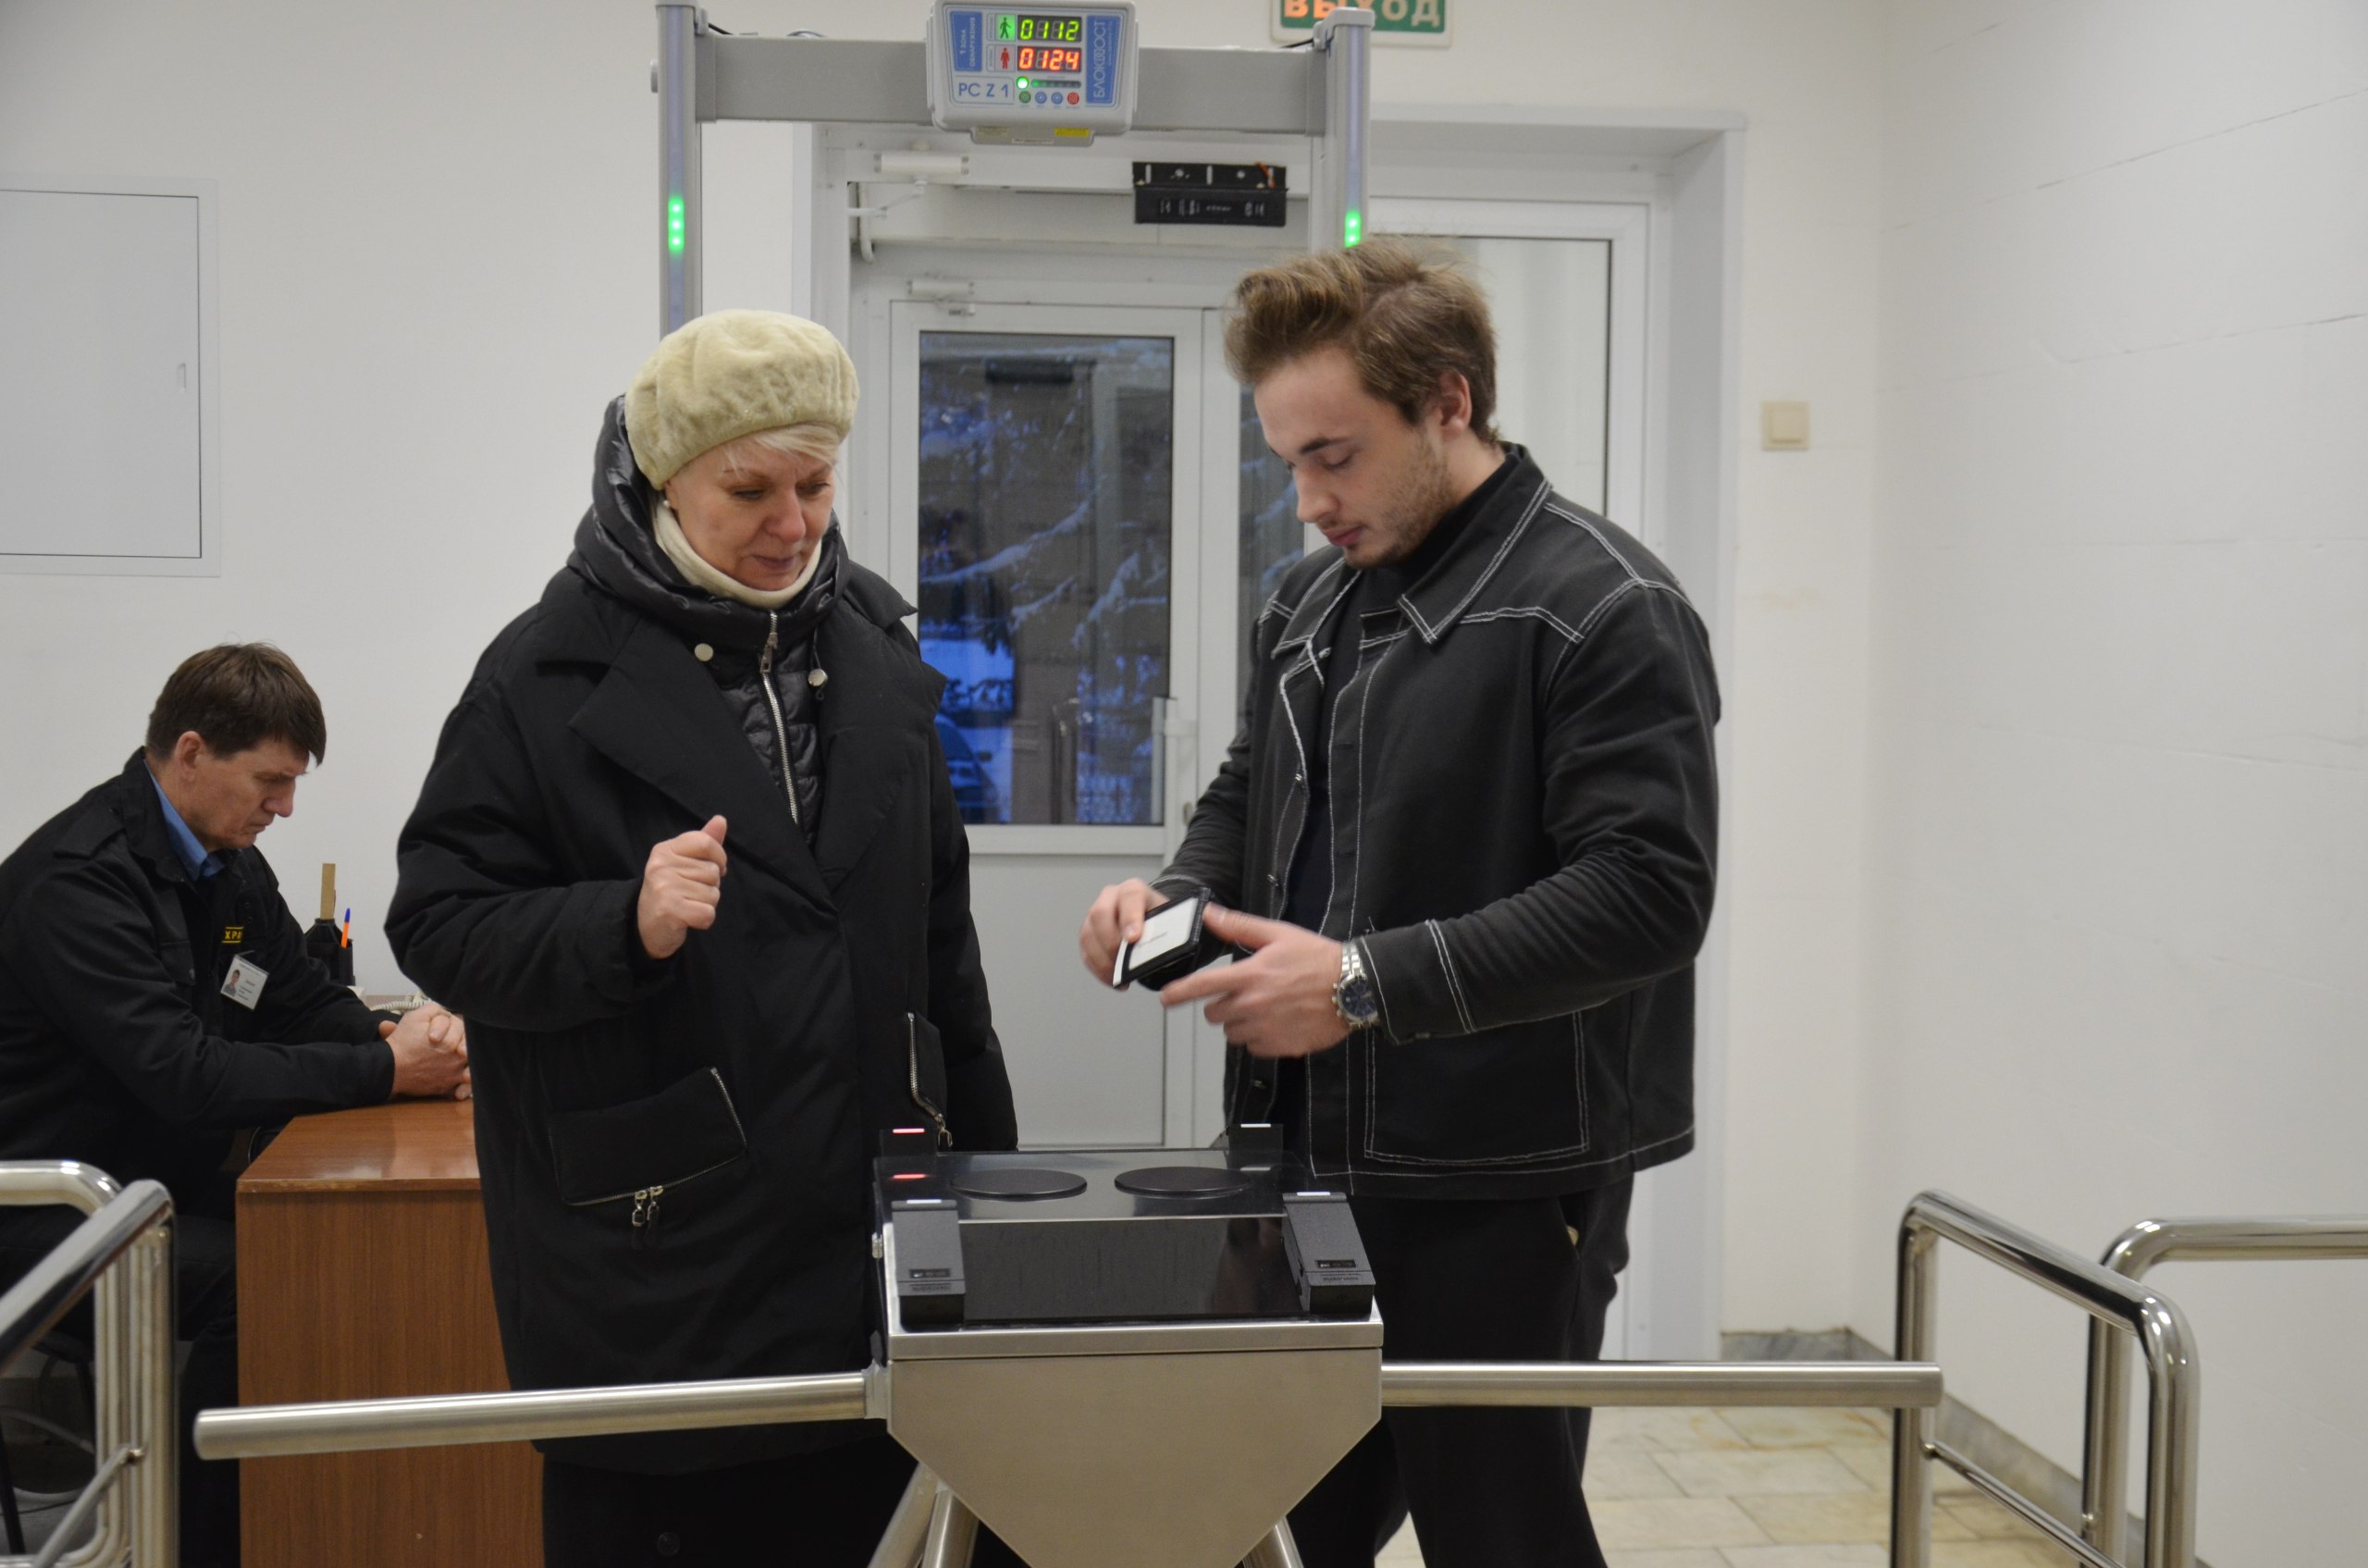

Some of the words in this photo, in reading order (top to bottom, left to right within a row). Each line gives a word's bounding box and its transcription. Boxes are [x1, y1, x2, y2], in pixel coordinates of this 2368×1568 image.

[1284, 0, 1440, 27] ВОД
[1020, 19, 1079, 41] 0112
[1018, 47, 1079, 70] 0124
[1001, 83, 1008, 98] 1
